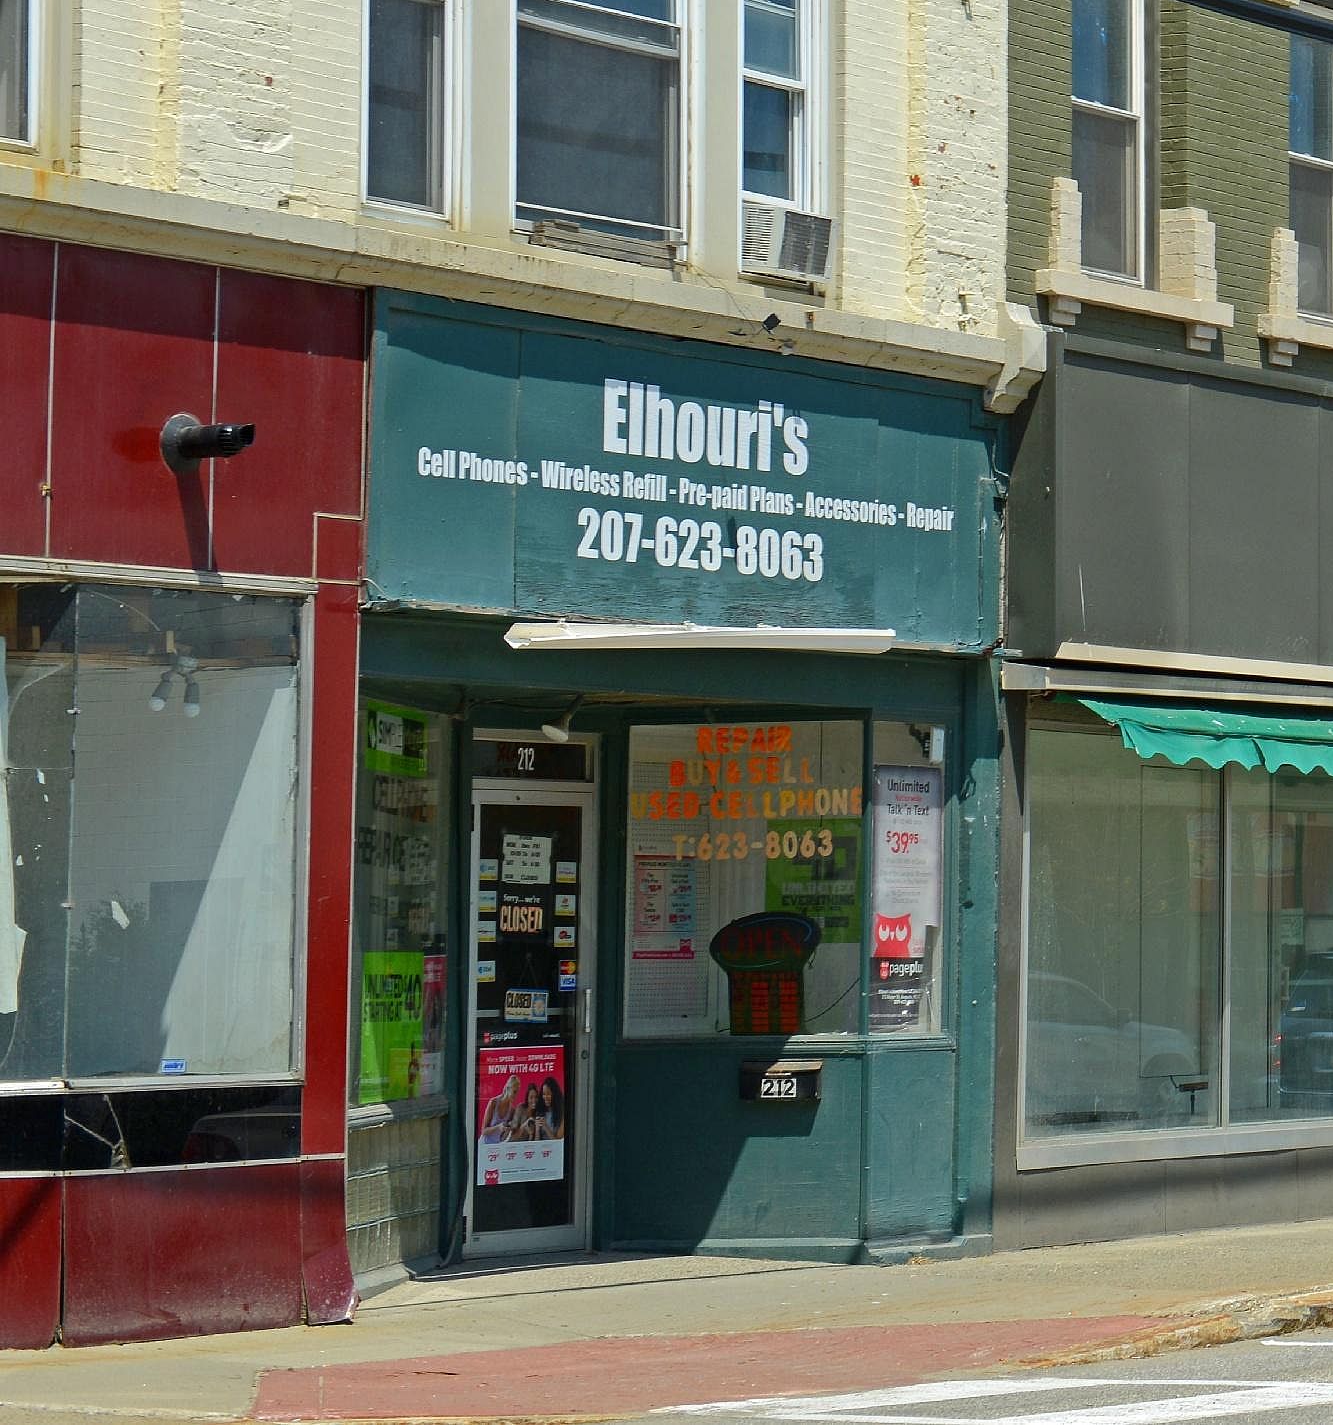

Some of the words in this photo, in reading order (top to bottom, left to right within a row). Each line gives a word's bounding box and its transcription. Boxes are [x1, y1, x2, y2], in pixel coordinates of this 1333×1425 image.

[603, 378, 810, 475] Elhouri's
[418, 446, 455, 479] Cell
[458, 450, 528, 486] Phones
[541, 460, 620, 497] Wireless
[622, 468, 667, 502] Refill
[678, 478, 748, 515] Pre-paid
[749, 484, 794, 516] Plans
[805, 491, 897, 528] Accessories
[906, 501, 954, 532] Repair
[577, 506, 825, 582] 207-623-8063
[696, 725, 794, 754] REPAIR
[517, 747, 535, 772] 212
[669, 757, 722, 787] BUY
[746, 756, 815, 784] SELL
[887, 778, 931, 793] Unlimited
[631, 789, 700, 821] USED
[709, 785, 863, 820] CELLPHONE
[887, 803, 902, 815] Talk
[913, 804, 930, 816] Text
[781, 894, 856, 907] EVERYTHING
[500, 905, 544, 933] CLOSED
[720, 926, 802, 961] OPEN
[506, 992, 532, 1009] CLOSED
[488, 1063, 507, 1075] NOW
[509, 1063, 528, 1074] WITH
[528, 1063, 539, 1072] 4G
[539, 1062, 555, 1072] LTE
[763, 1079, 795, 1096] 212
